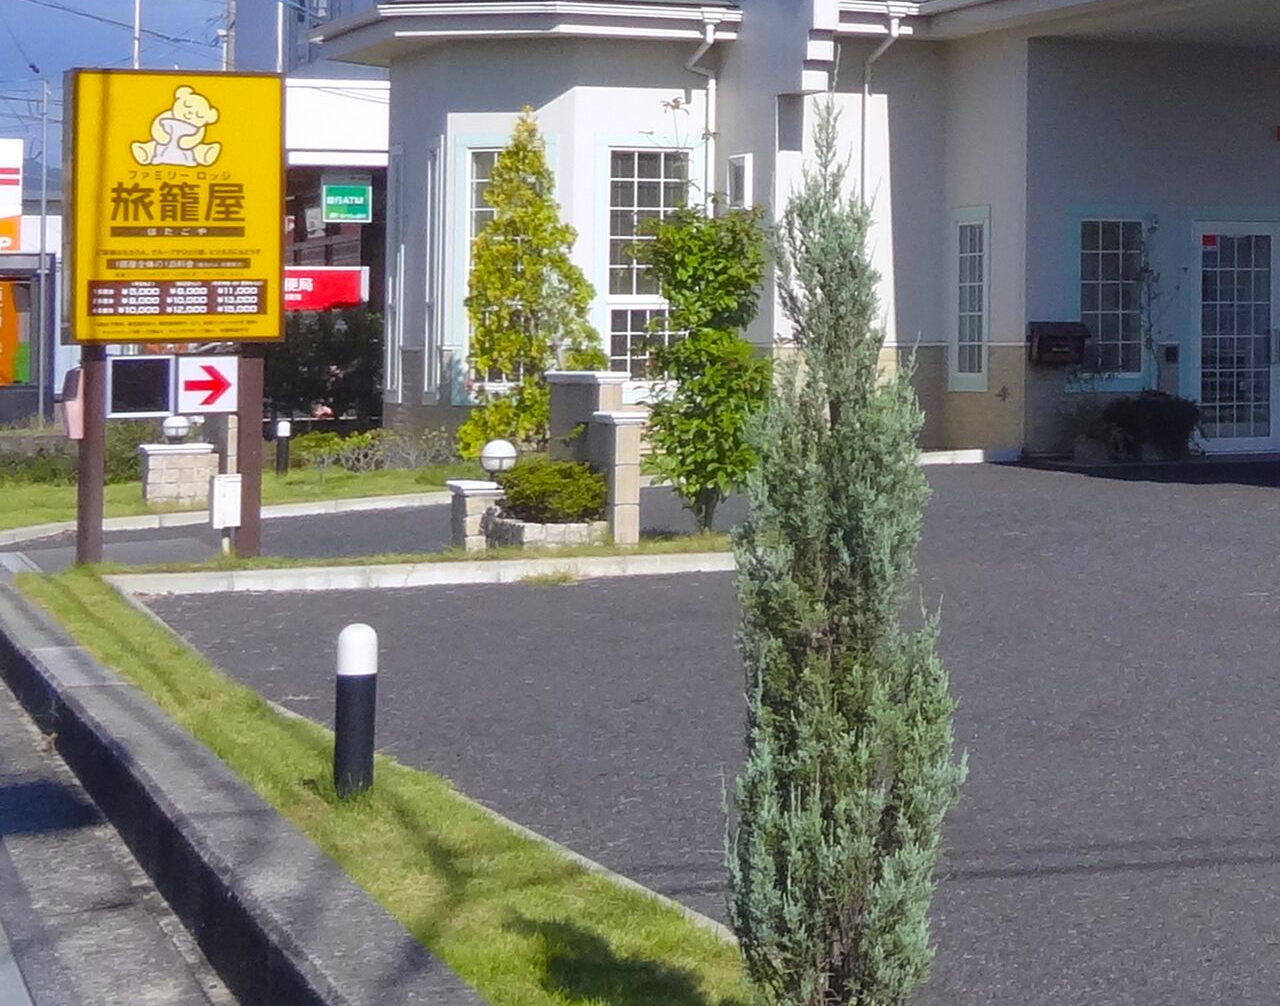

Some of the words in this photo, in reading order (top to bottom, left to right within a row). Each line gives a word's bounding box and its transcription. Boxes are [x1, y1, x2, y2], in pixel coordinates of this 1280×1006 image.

[128, 170, 190, 181] ファミリー
[196, 170, 232, 181] ロッジ
[110, 181, 246, 222] 旅籠屋
